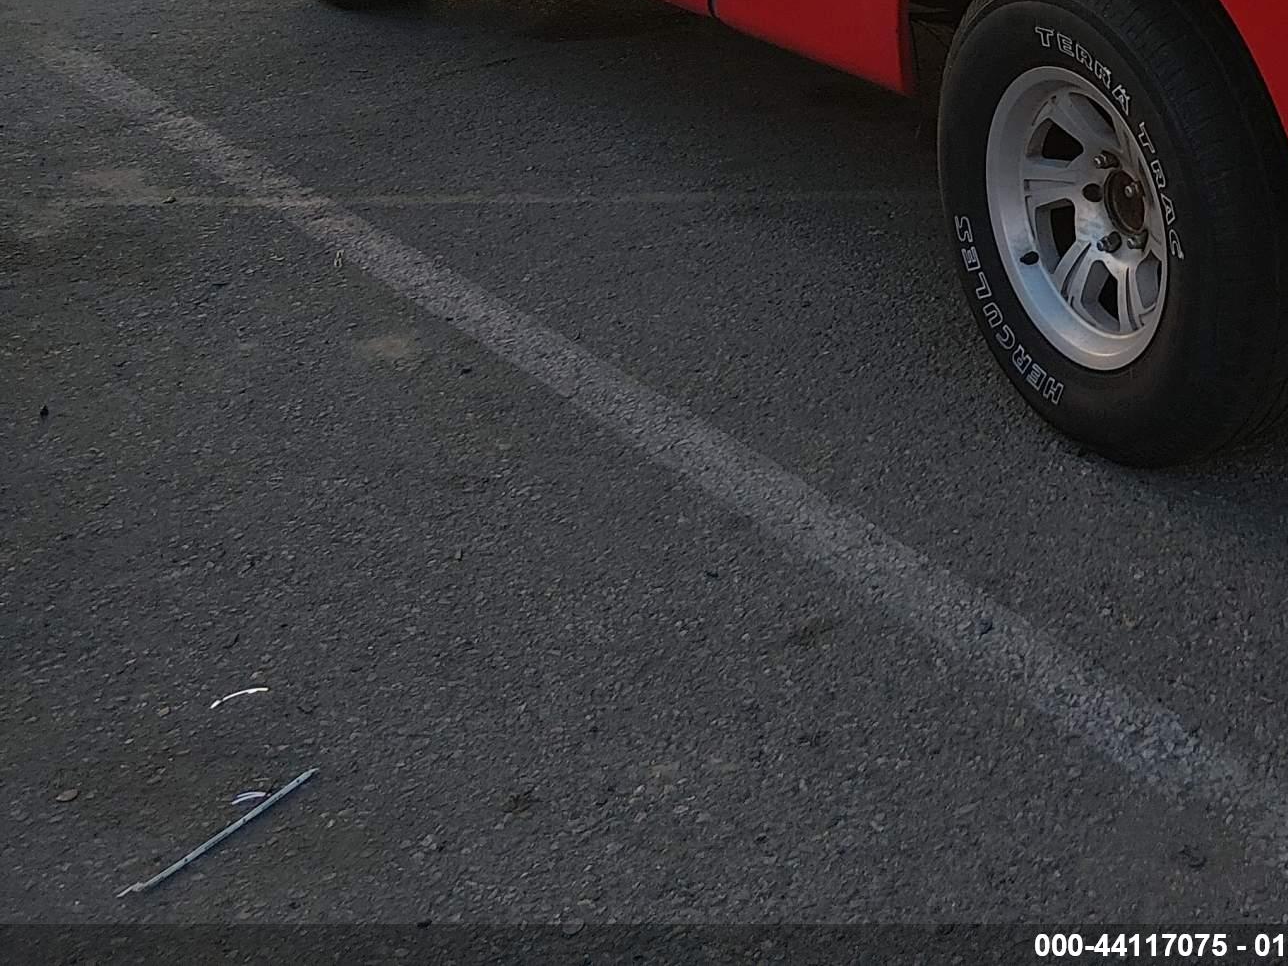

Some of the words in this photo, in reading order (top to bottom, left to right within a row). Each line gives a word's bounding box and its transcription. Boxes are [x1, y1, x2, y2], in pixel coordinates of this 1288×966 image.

[1034, 26, 1131, 116] TERRA
[1137, 121, 1184, 260] TRAC
[955, 215, 1064, 405] HERCULES
